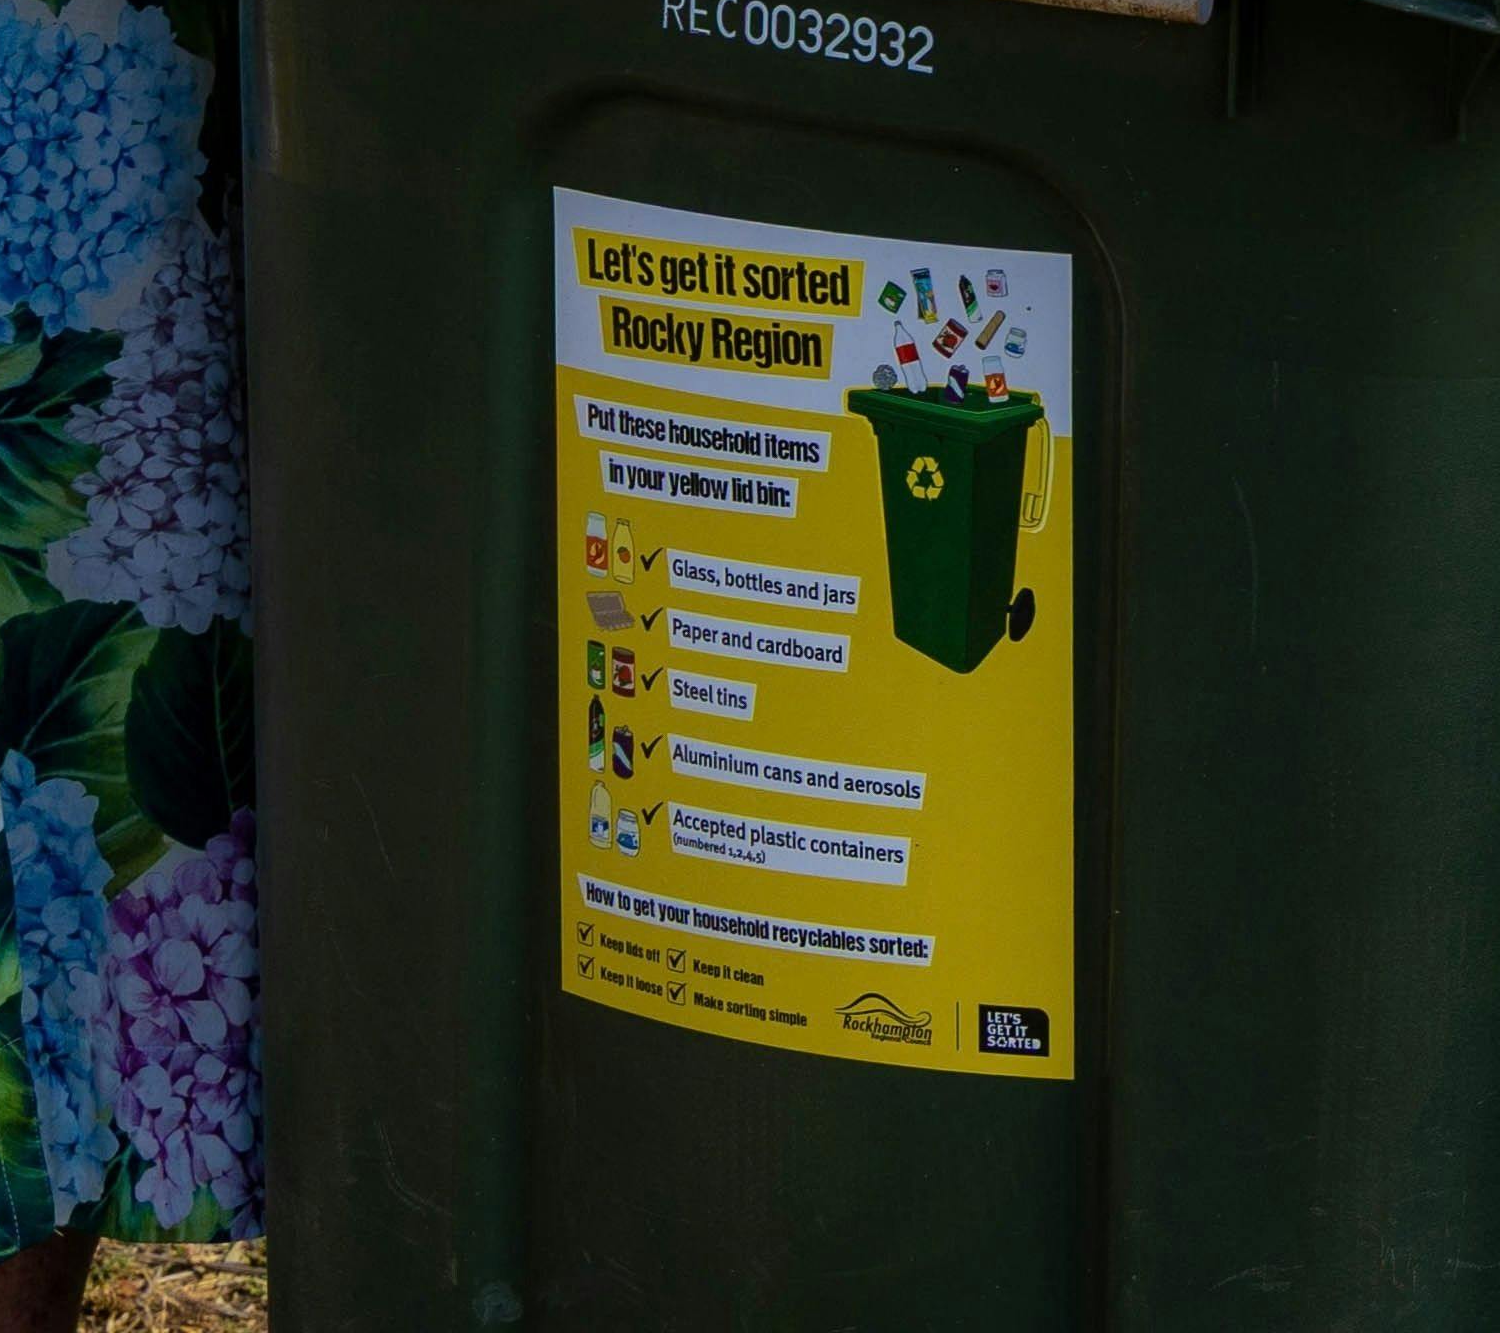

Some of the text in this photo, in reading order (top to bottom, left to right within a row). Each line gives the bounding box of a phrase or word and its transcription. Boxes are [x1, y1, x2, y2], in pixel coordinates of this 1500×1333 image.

[587, 237, 850, 306] Let's get it sorted
[611, 305, 822, 369] Rocky Region
[587, 403, 820, 464] Put these household items
[608, 458, 791, 507] in your yellow lid bin:
[672, 559, 856, 606] Glass, bottles and jars
[672, 617, 843, 664] Paper and cardboard
[672, 678, 748, 710] Steel tins
[672, 744, 921, 800] Aluminium cans and aerosols
[673, 808, 904, 864] Accepted plastic containers
[673, 832, 726, 856] (numbered
[586, 881, 929, 960] How to get your household recyclables sorted:
[600, 933, 661, 964] Keep lids off
[600, 966, 664, 997] Keep it loose
[693, 959, 765, 987] Keep it clean
[693, 991, 808, 1027] Make sorting simple
[843, 1014, 933, 1039] Rockhampton
[987, 1011, 1022, 1025] LET'S
[987, 1024, 1029, 1038] GET IT
[987, 1035, 1042, 1050] SORTED
